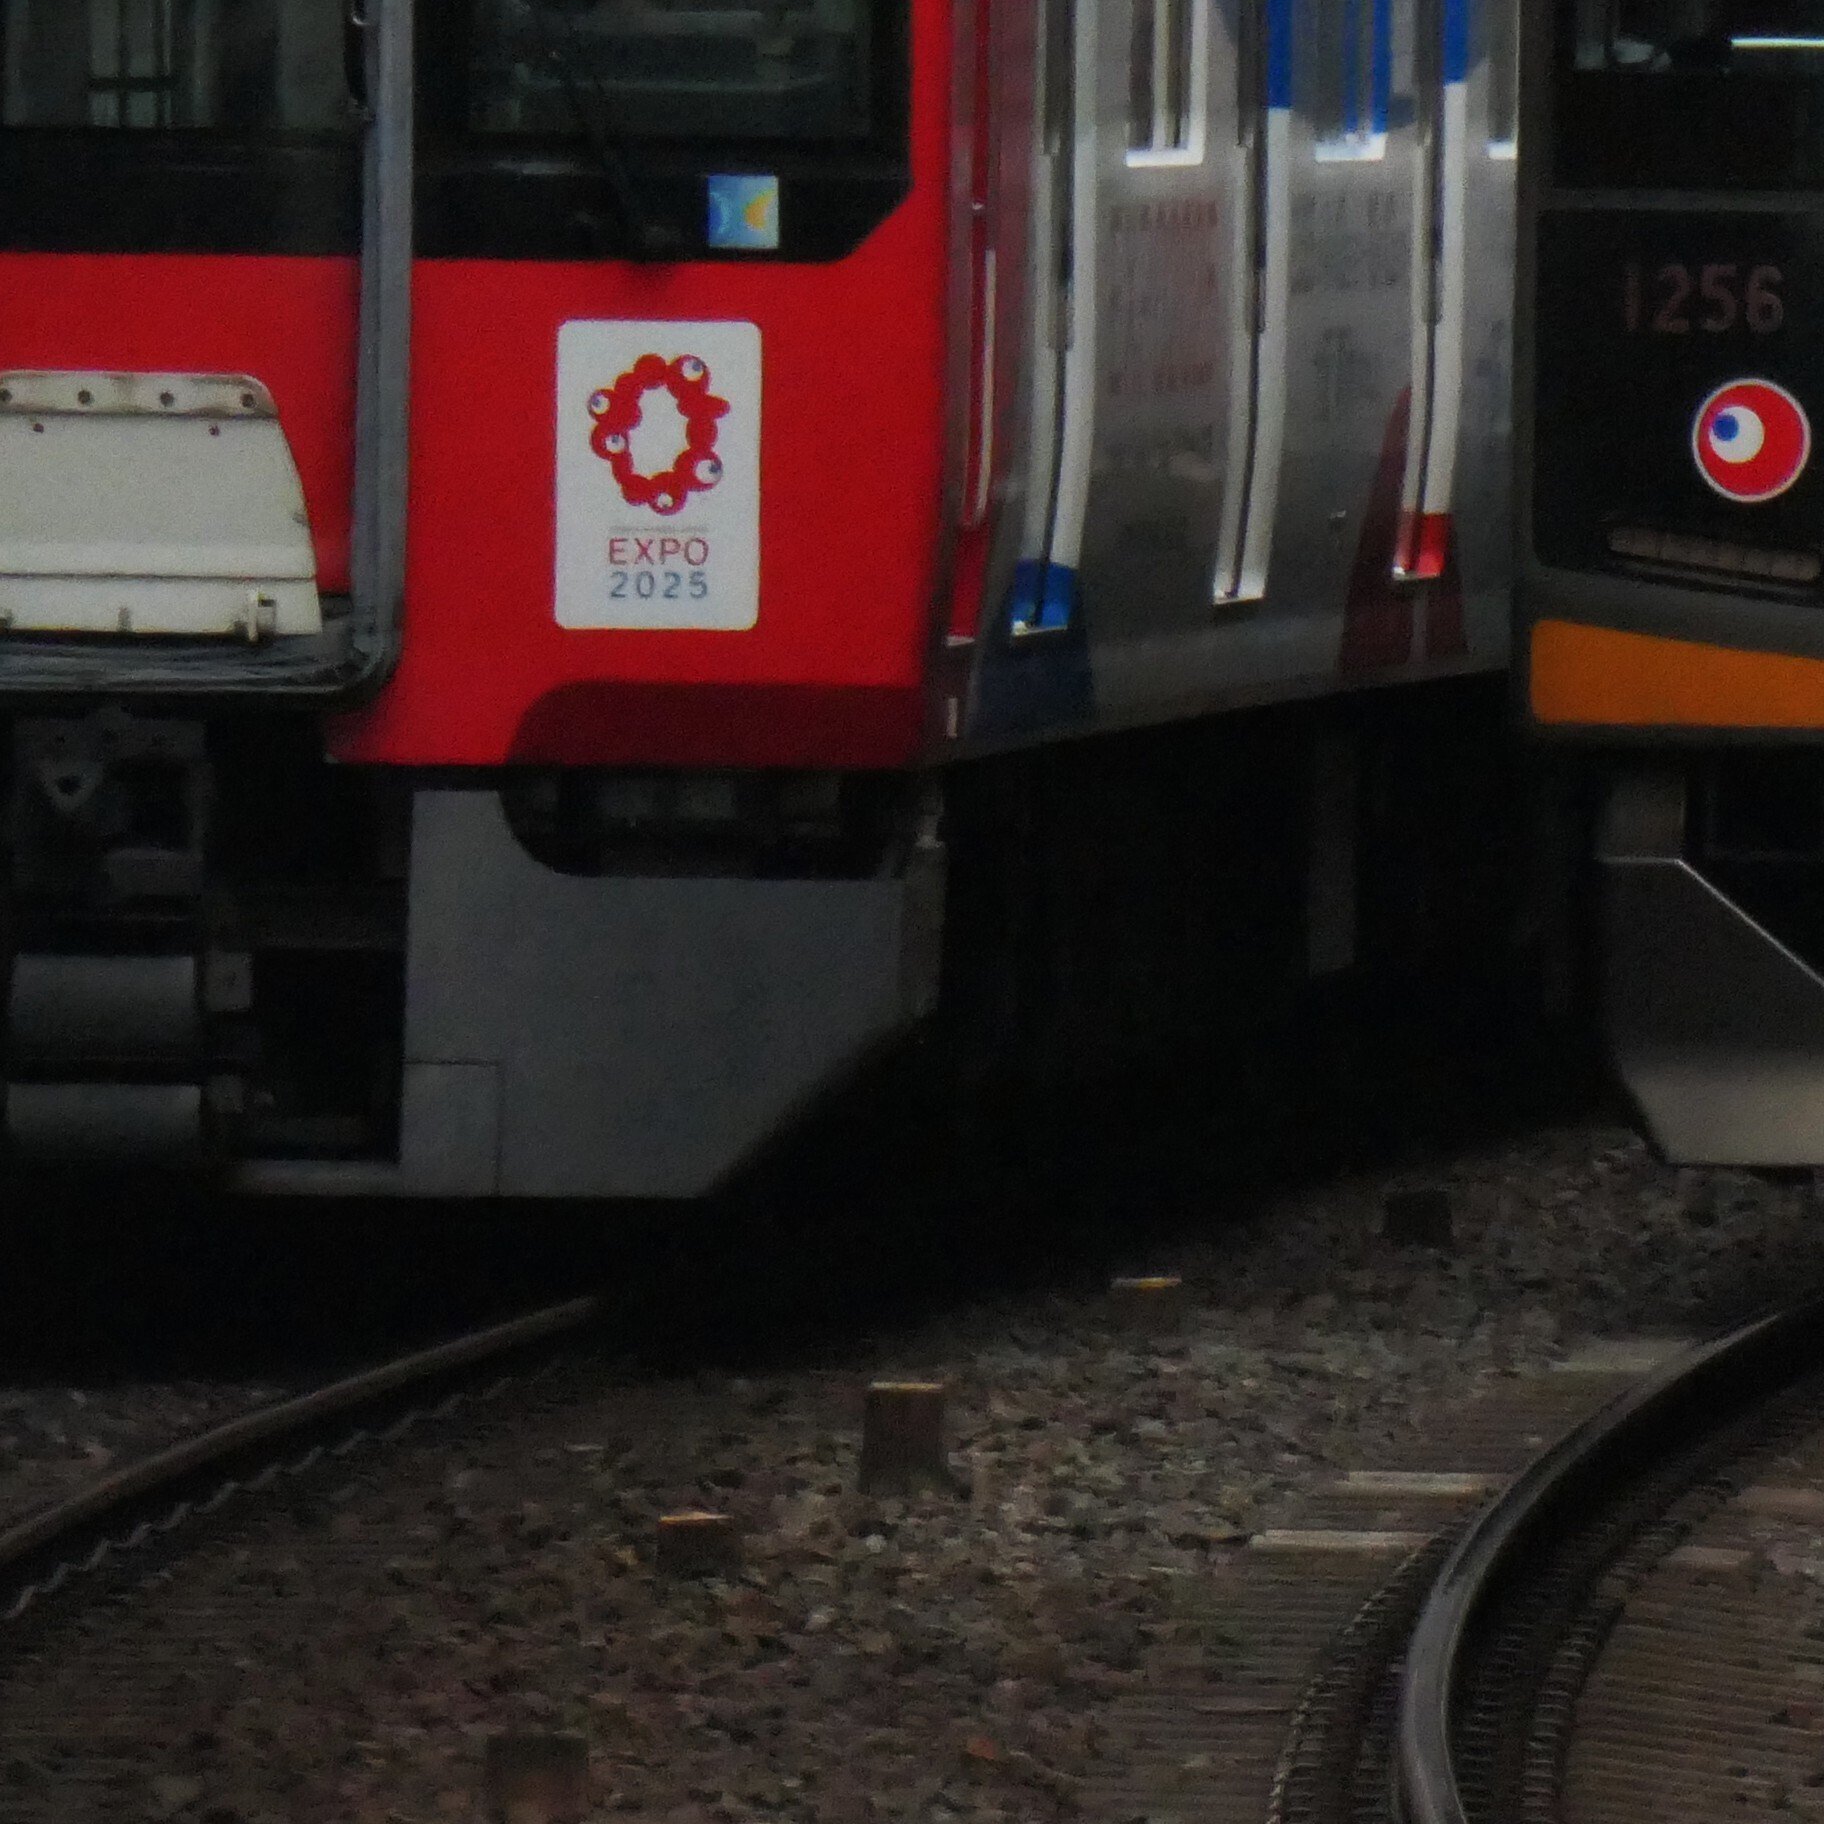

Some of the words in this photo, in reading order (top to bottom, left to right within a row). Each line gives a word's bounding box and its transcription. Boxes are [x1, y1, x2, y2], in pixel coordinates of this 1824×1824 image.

[1624, 263, 1785, 334] 1256
[608, 537, 709, 566] EXPO
[610, 570, 708, 599] 2025
